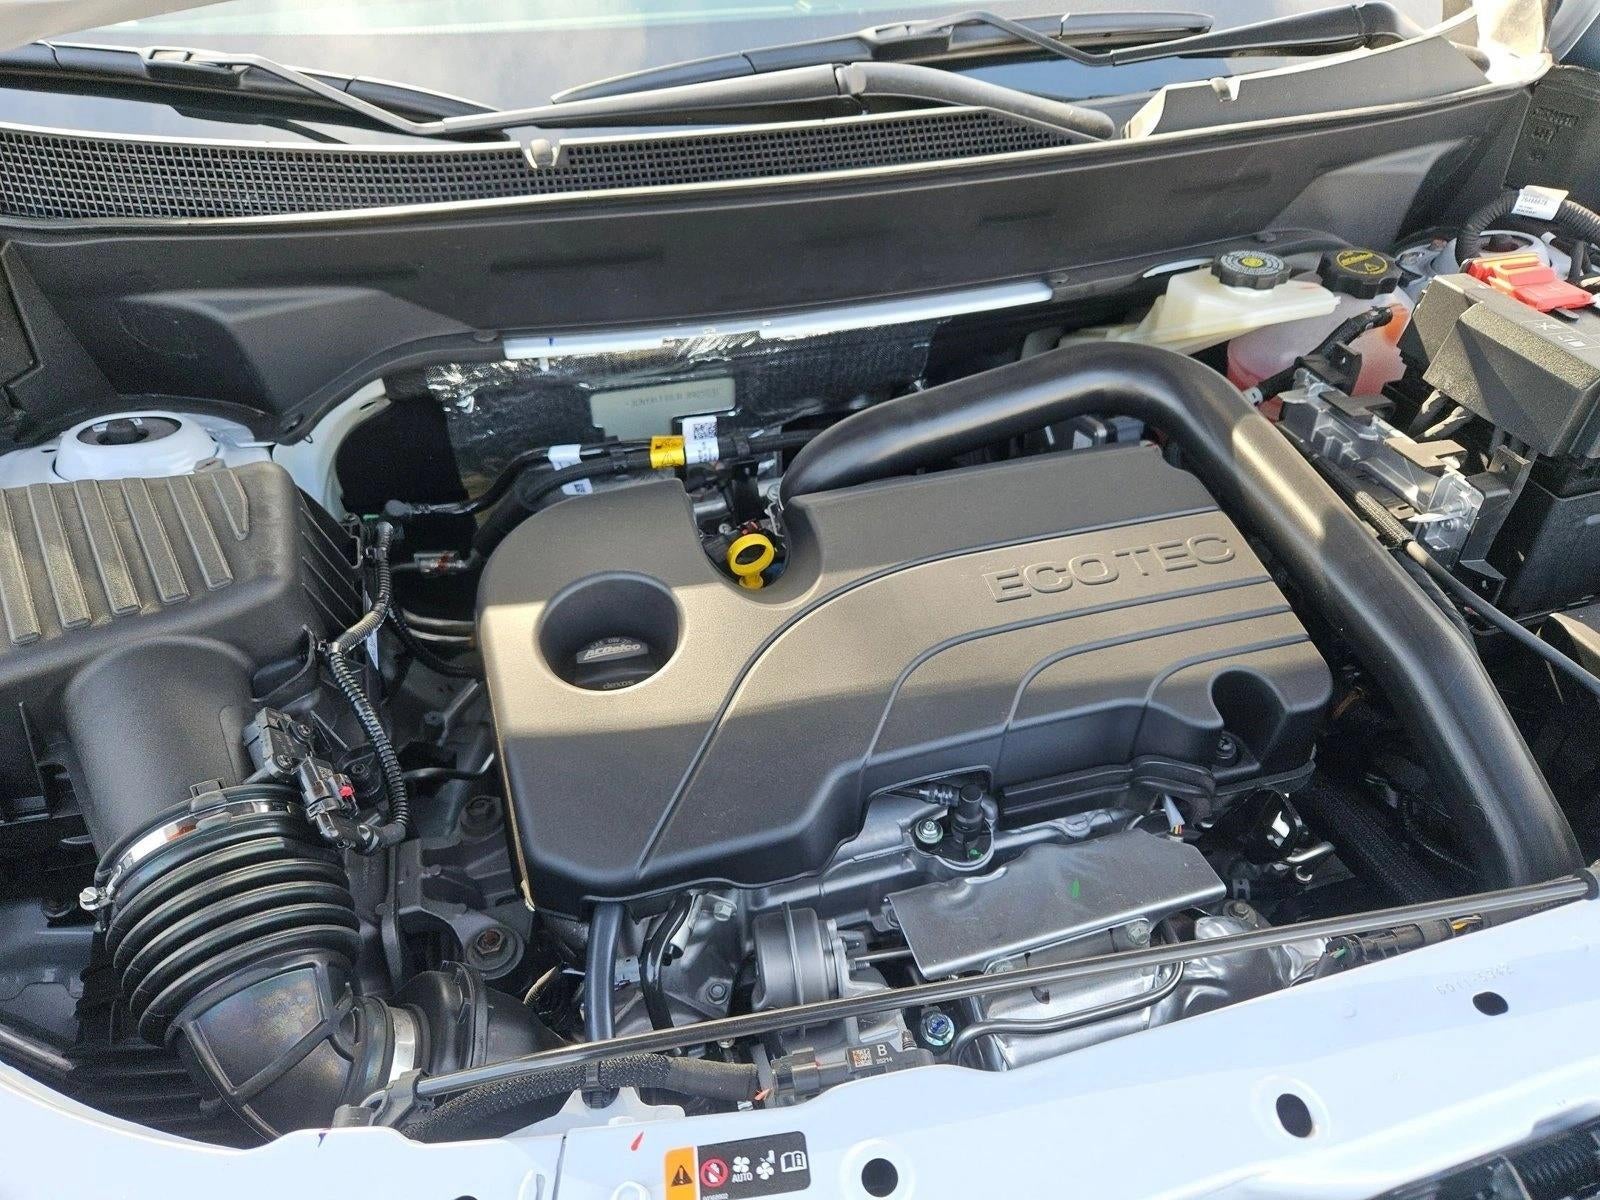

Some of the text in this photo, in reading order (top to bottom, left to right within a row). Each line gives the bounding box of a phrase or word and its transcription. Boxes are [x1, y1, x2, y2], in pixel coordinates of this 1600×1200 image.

[982, 533, 1236, 604] ECOTEC
[877, 1044, 888, 1057] B
[731, 1171, 754, 1184] AUTO
